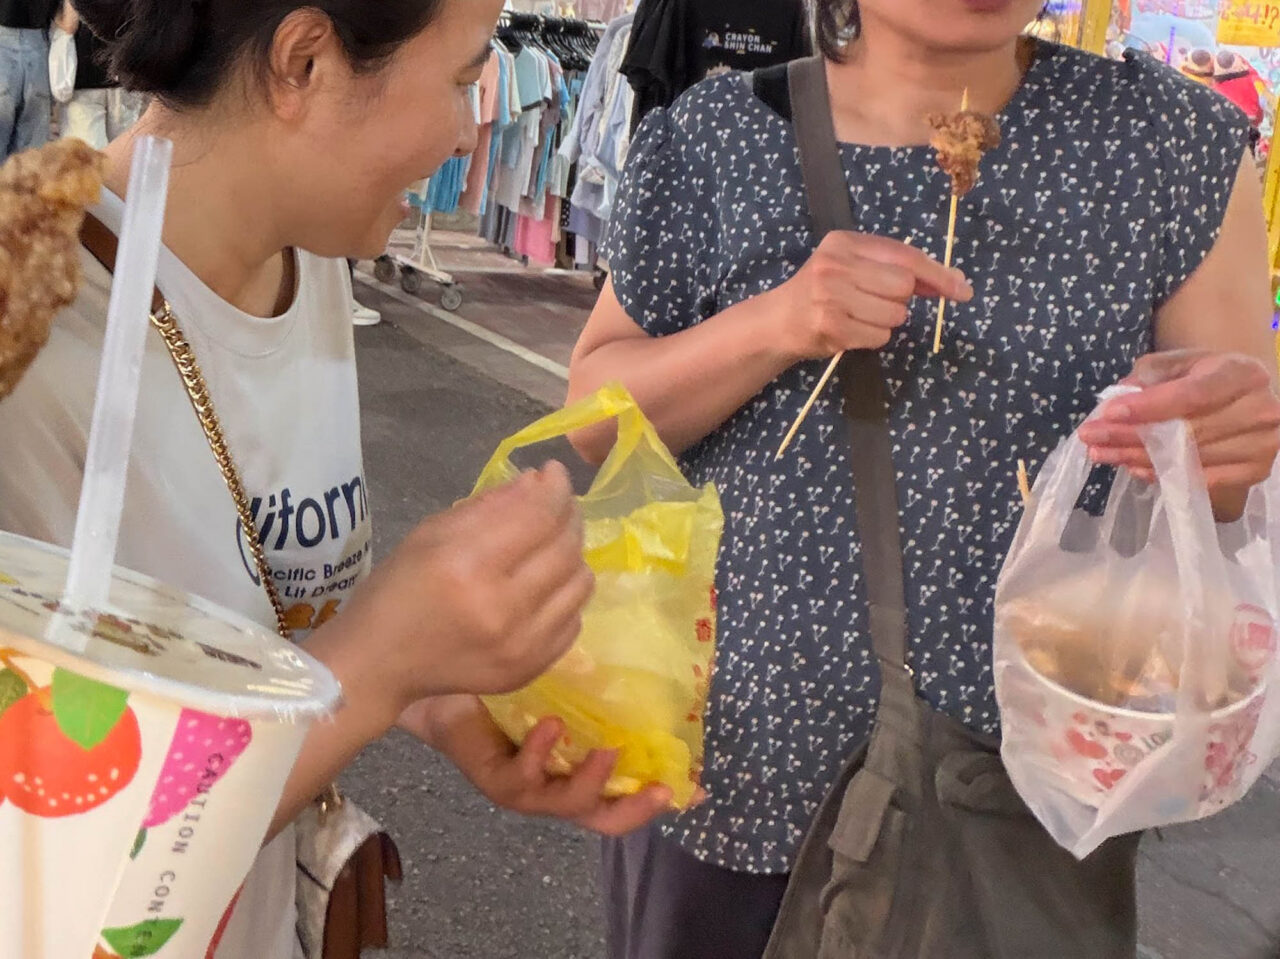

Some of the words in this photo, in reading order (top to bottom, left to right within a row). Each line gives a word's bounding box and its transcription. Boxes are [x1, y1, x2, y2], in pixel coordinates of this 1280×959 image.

[725, 32, 760, 43] CRAYON
[748, 43, 772, 54] CHAN
[171, 752, 225, 855] CAUTION
